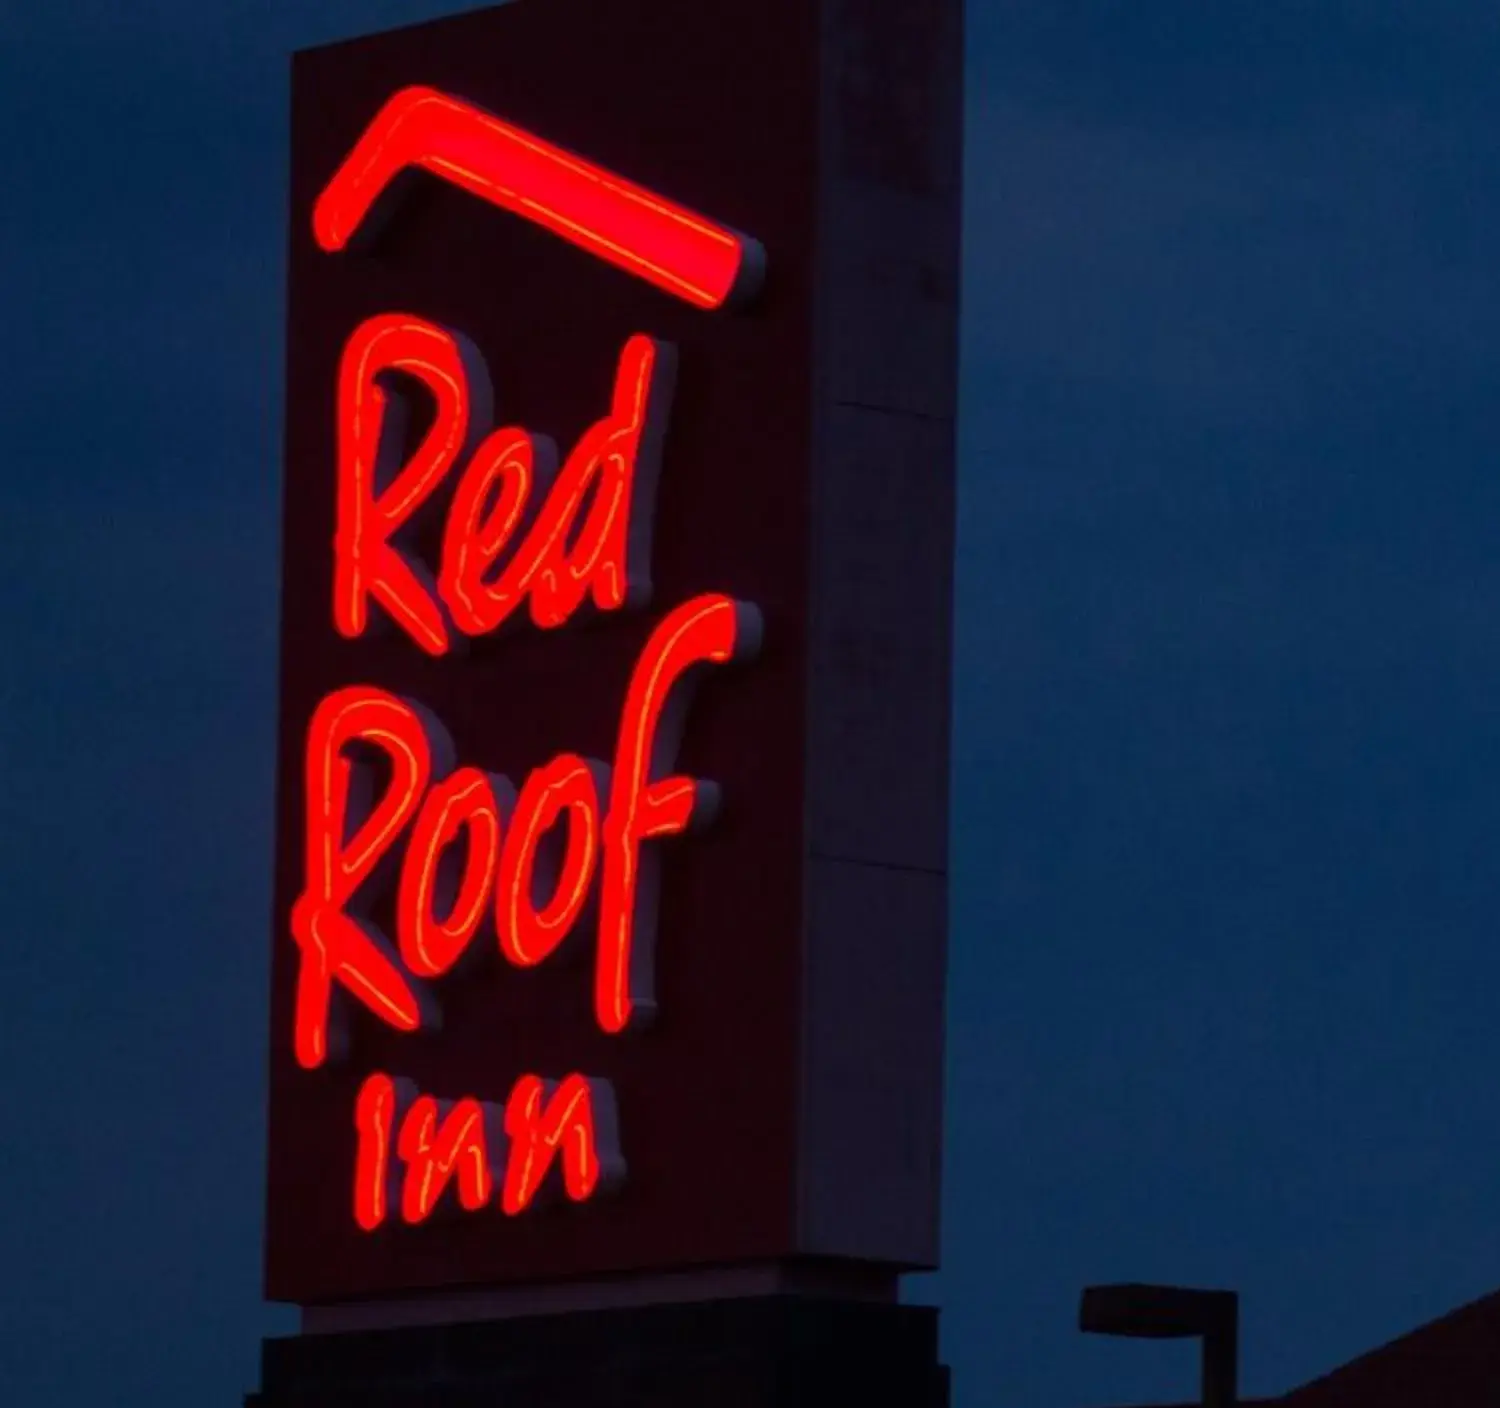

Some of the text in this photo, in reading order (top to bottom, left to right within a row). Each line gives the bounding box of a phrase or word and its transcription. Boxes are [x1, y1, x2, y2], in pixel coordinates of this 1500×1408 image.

[333, 313, 656, 656] Red
[291, 593, 737, 1069] Roof
[354, 1072, 600, 1231] Inn
